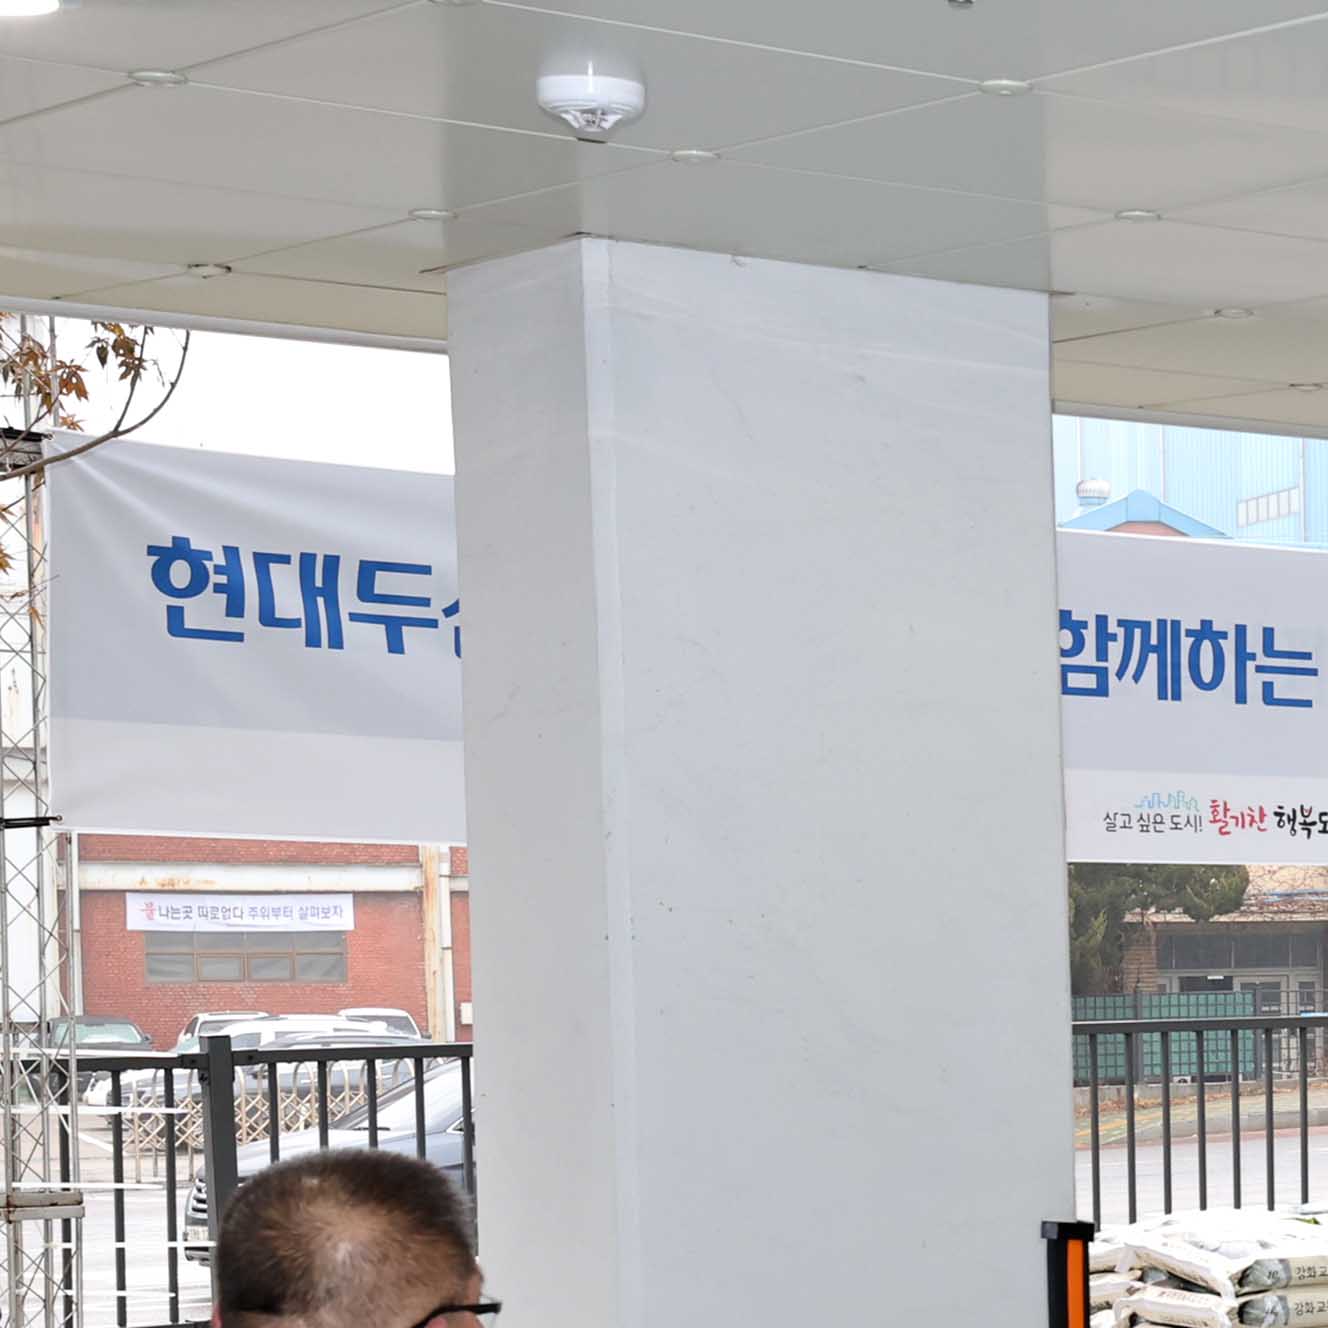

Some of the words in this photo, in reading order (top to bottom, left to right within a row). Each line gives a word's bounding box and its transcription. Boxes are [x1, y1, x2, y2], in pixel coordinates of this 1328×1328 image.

[147, 535, 462, 659] 현대두
[1058, 609, 1319, 708] 함께하는
[1103, 812, 1133, 833] 살고
[1137, 812, 1166, 833] 싶은
[1169, 814, 1203, 833] 도시!
[1208, 800, 1268, 836] 활기찬
